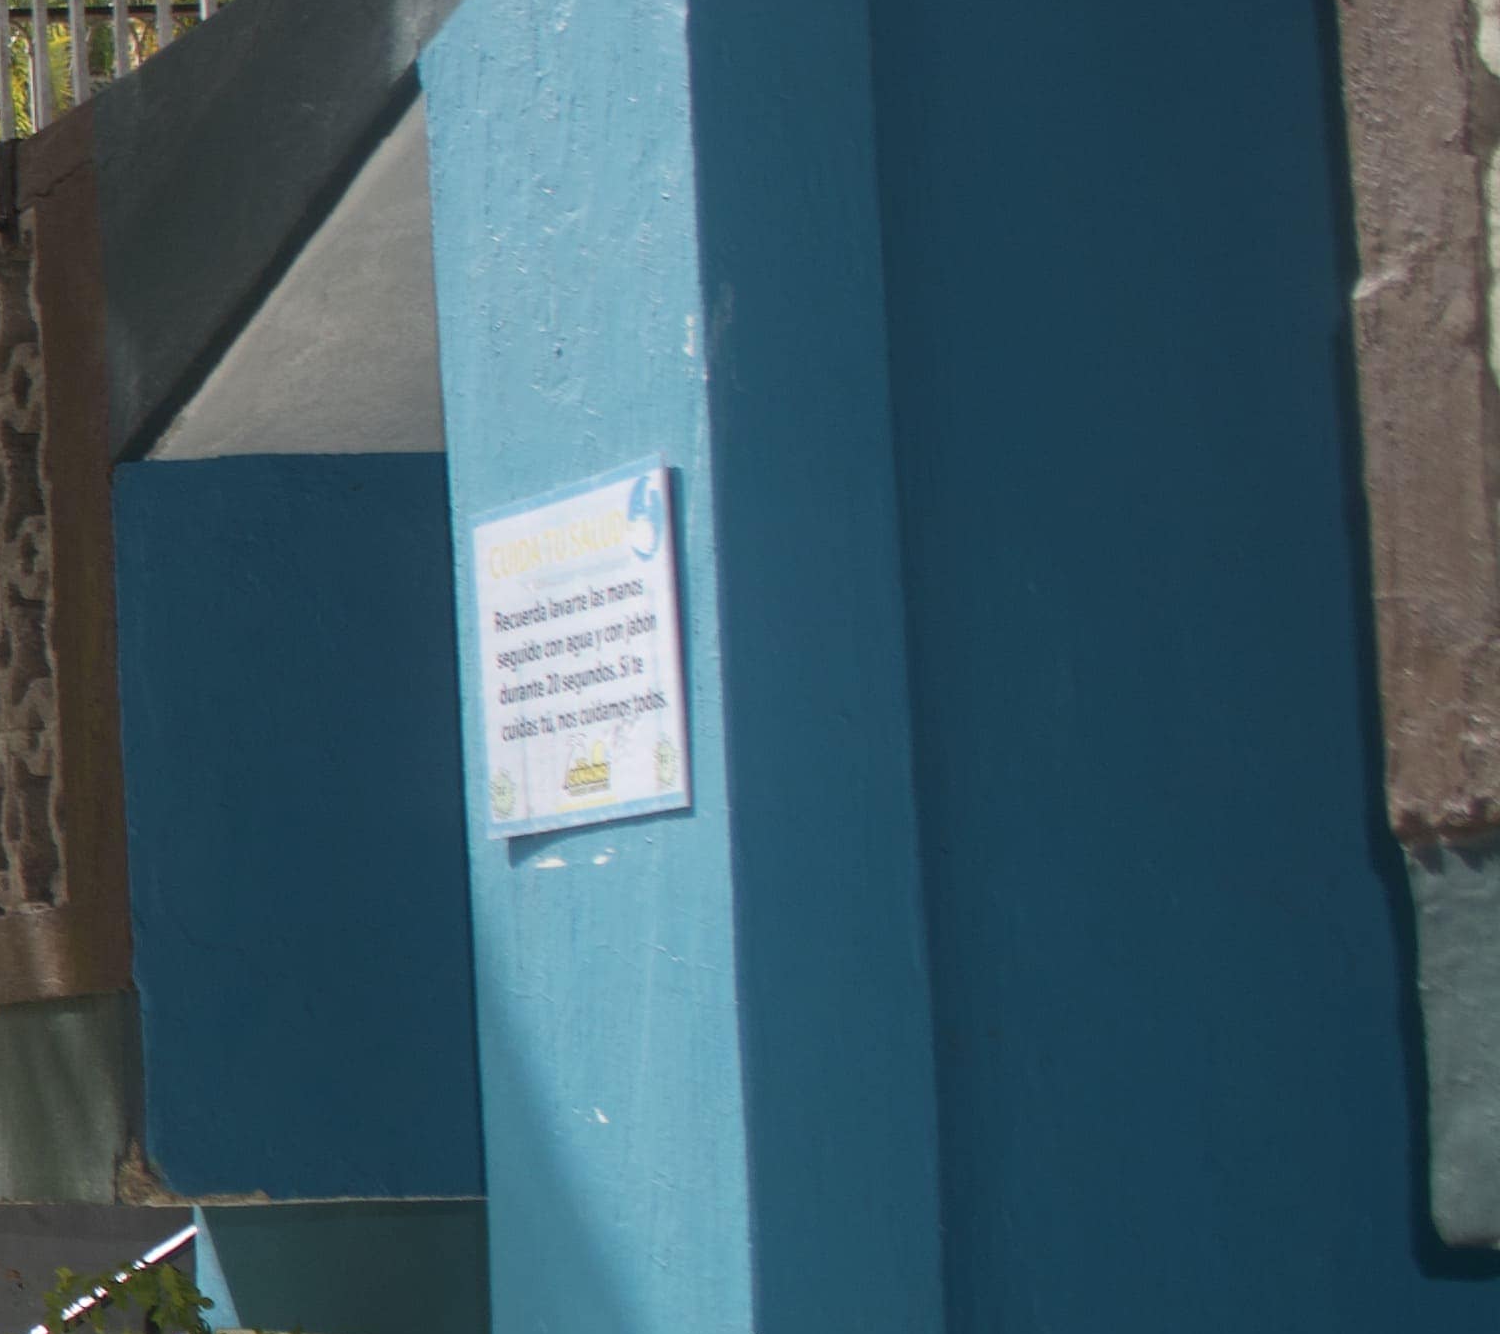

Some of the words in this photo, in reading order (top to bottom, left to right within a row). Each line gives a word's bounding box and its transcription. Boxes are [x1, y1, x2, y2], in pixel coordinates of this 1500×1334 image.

[490, 535, 542, 579] CUIDA
[542, 527, 567, 561] TU
[493, 599, 547, 633] Recuerda
[548, 596, 588, 618] lavarte
[589, 585, 605, 607] las
[607, 578, 644, 603] manos
[496, 638, 542, 672] seguido
[544, 639, 564, 658] con
[566, 631, 594, 657] agua
[595, 629, 602, 651] y
[604, 623, 624, 643] con
[499, 680, 545, 705] durante
[546, 673, 561, 695] 20
[632, 655, 644, 675] te
[502, 716, 539, 742] cuidas
[557, 712, 578, 729] nos
[579, 698, 632, 726] cuidamos
